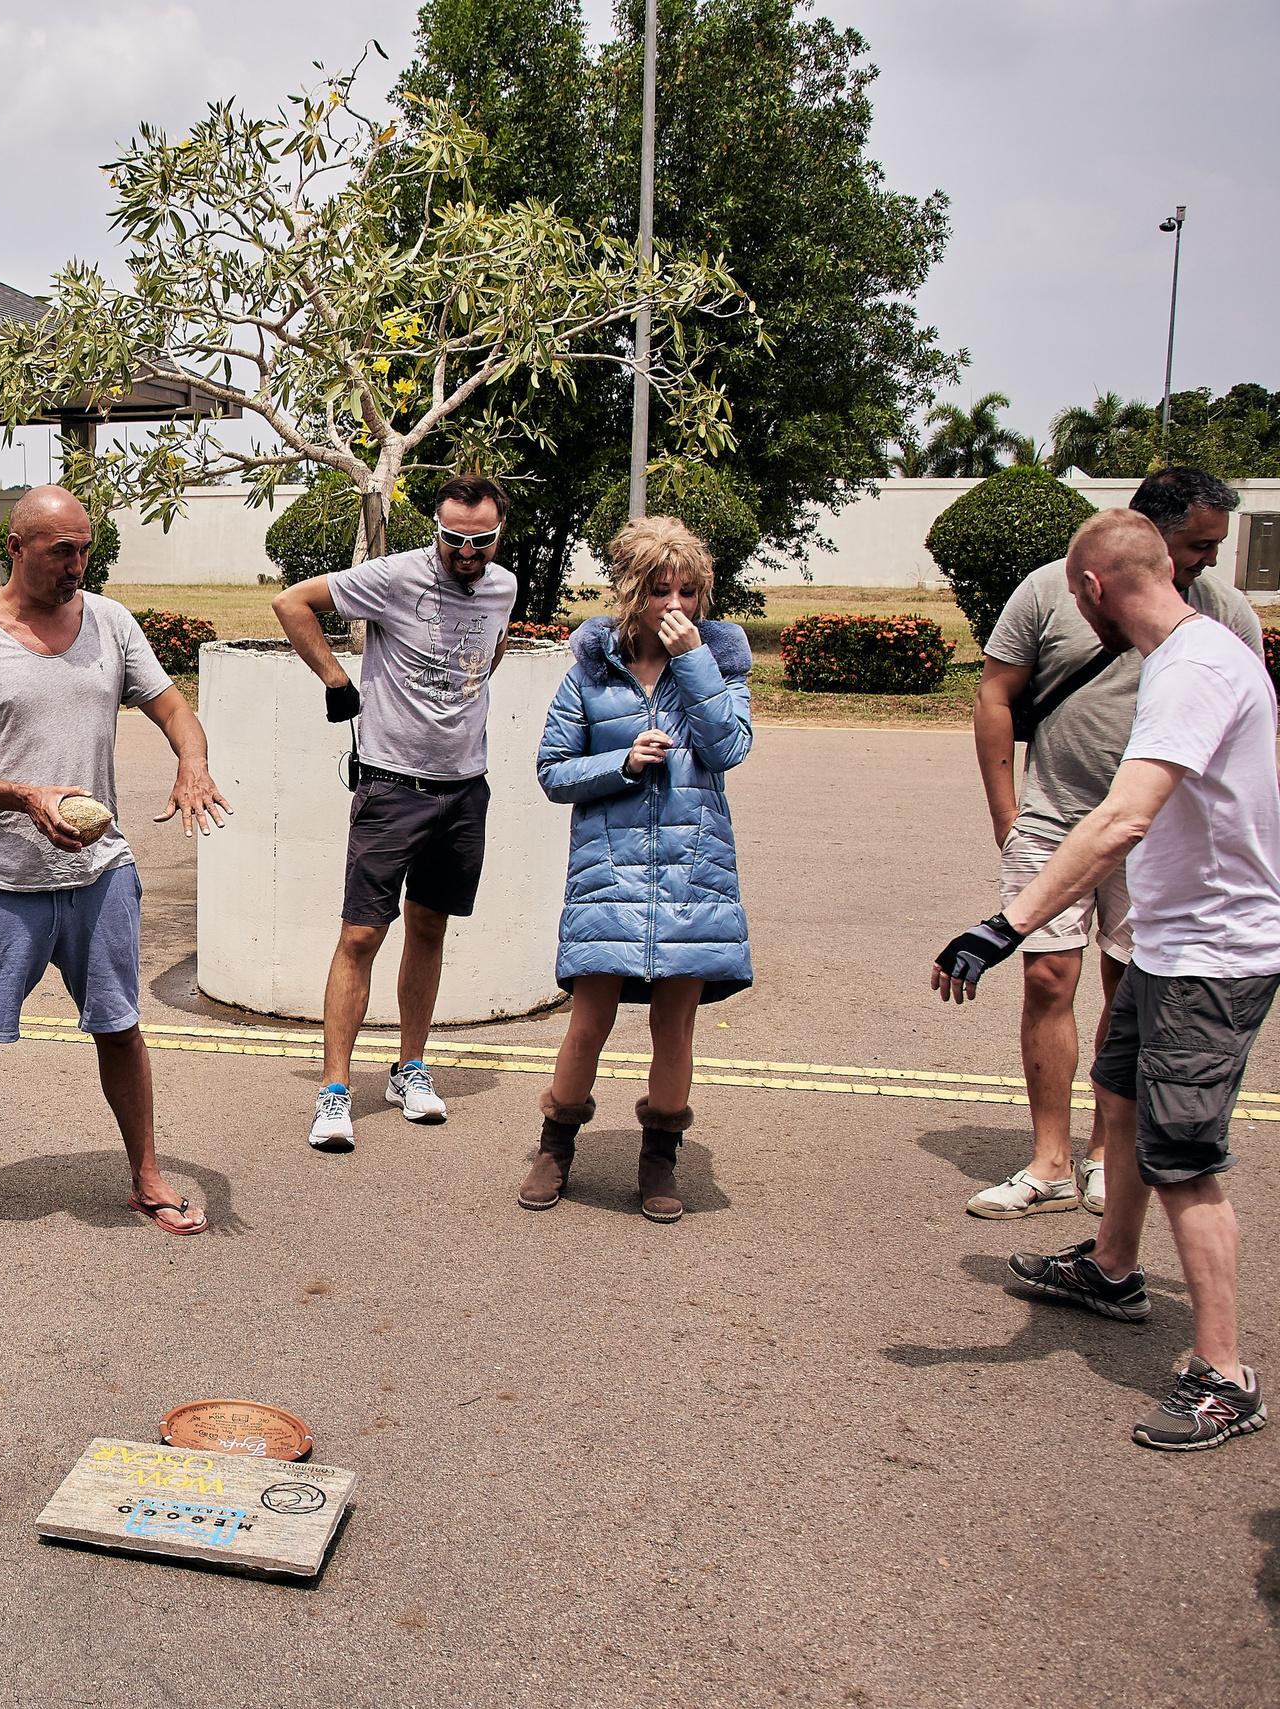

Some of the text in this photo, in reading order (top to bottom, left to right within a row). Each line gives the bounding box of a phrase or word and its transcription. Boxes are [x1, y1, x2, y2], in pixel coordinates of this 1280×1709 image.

[93, 1445, 213, 1473] OSCAR
[123, 1469, 223, 1495] WOW
[118, 1505, 253, 1532] MEGOGO
